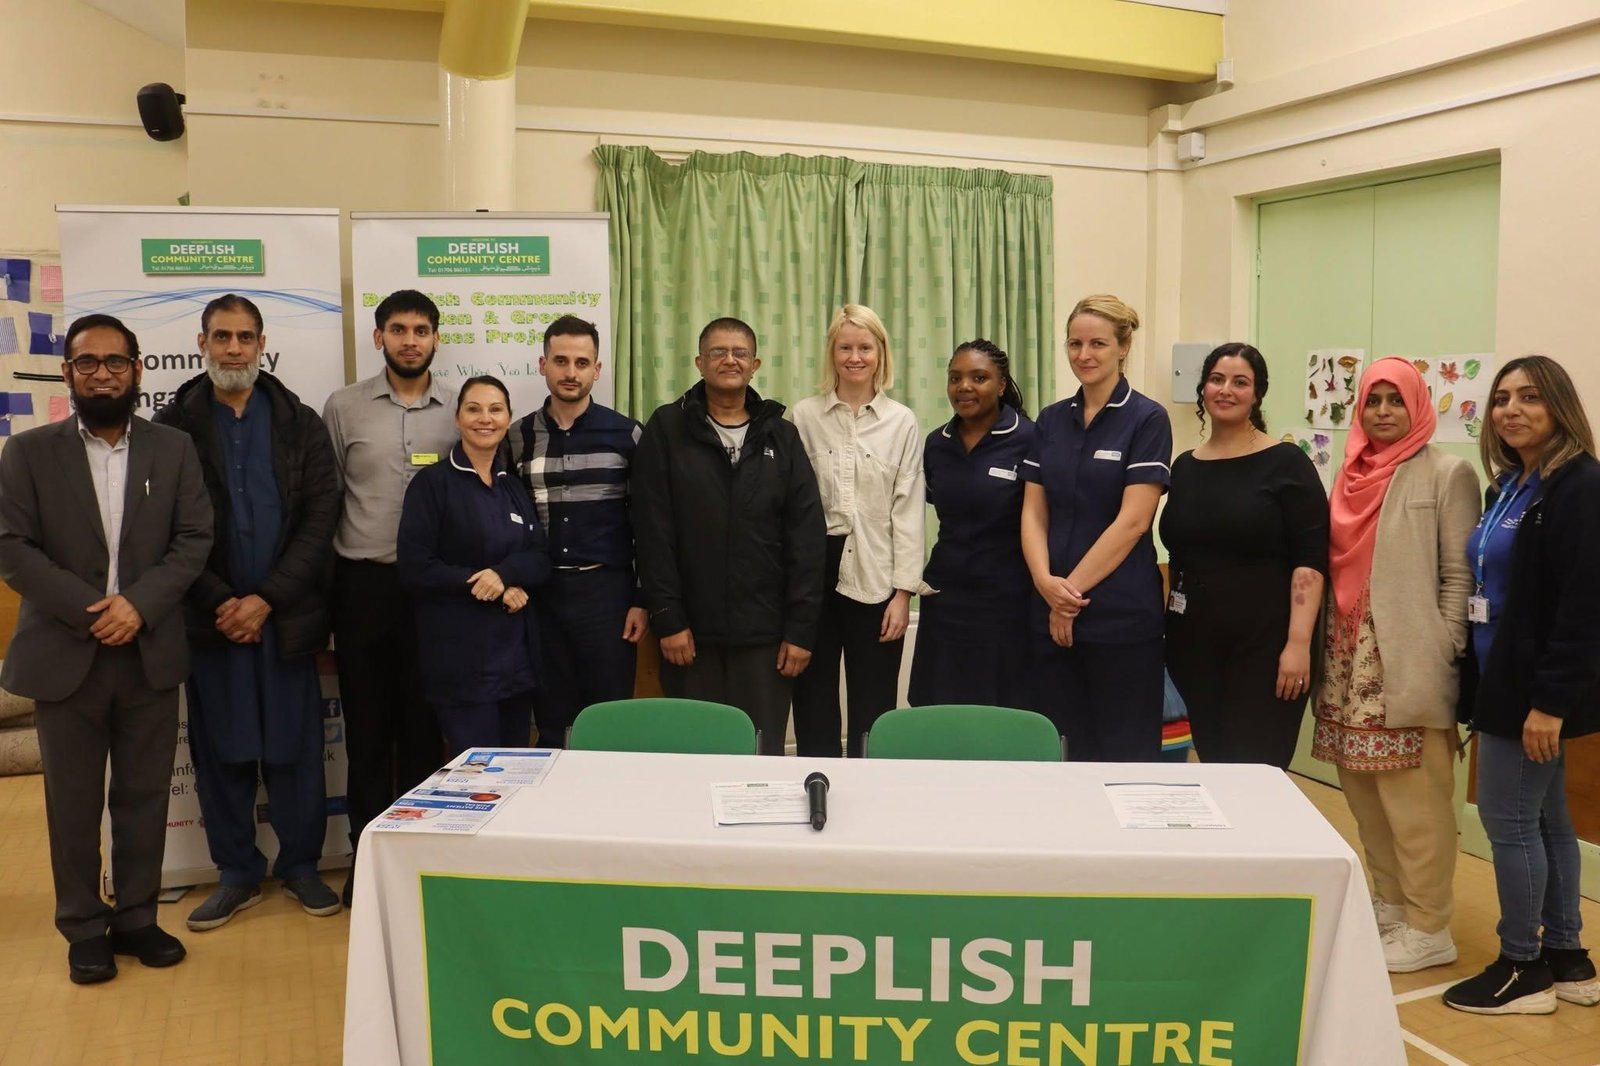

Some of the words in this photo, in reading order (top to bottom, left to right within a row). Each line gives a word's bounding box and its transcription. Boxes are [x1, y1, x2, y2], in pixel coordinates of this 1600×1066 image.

[169, 244, 236, 255] DEEPLISH
[448, 242, 520, 255] DEEPLISH
[150, 255, 214, 263] COMMUNITY
[216, 255, 255, 263] CENTRE
[427, 256, 496, 264] COMMUNITY
[498, 255, 541, 264] CENTRE
[470, 291, 601, 308] Community
[511, 310, 578, 325] Gree
[486, 329, 545, 345] Proje
[622, 926, 1092, 1006] DEEPLISH
[491, 998, 932, 1062] COMMUNITY
[955, 1020, 1235, 1066] CENTRE
